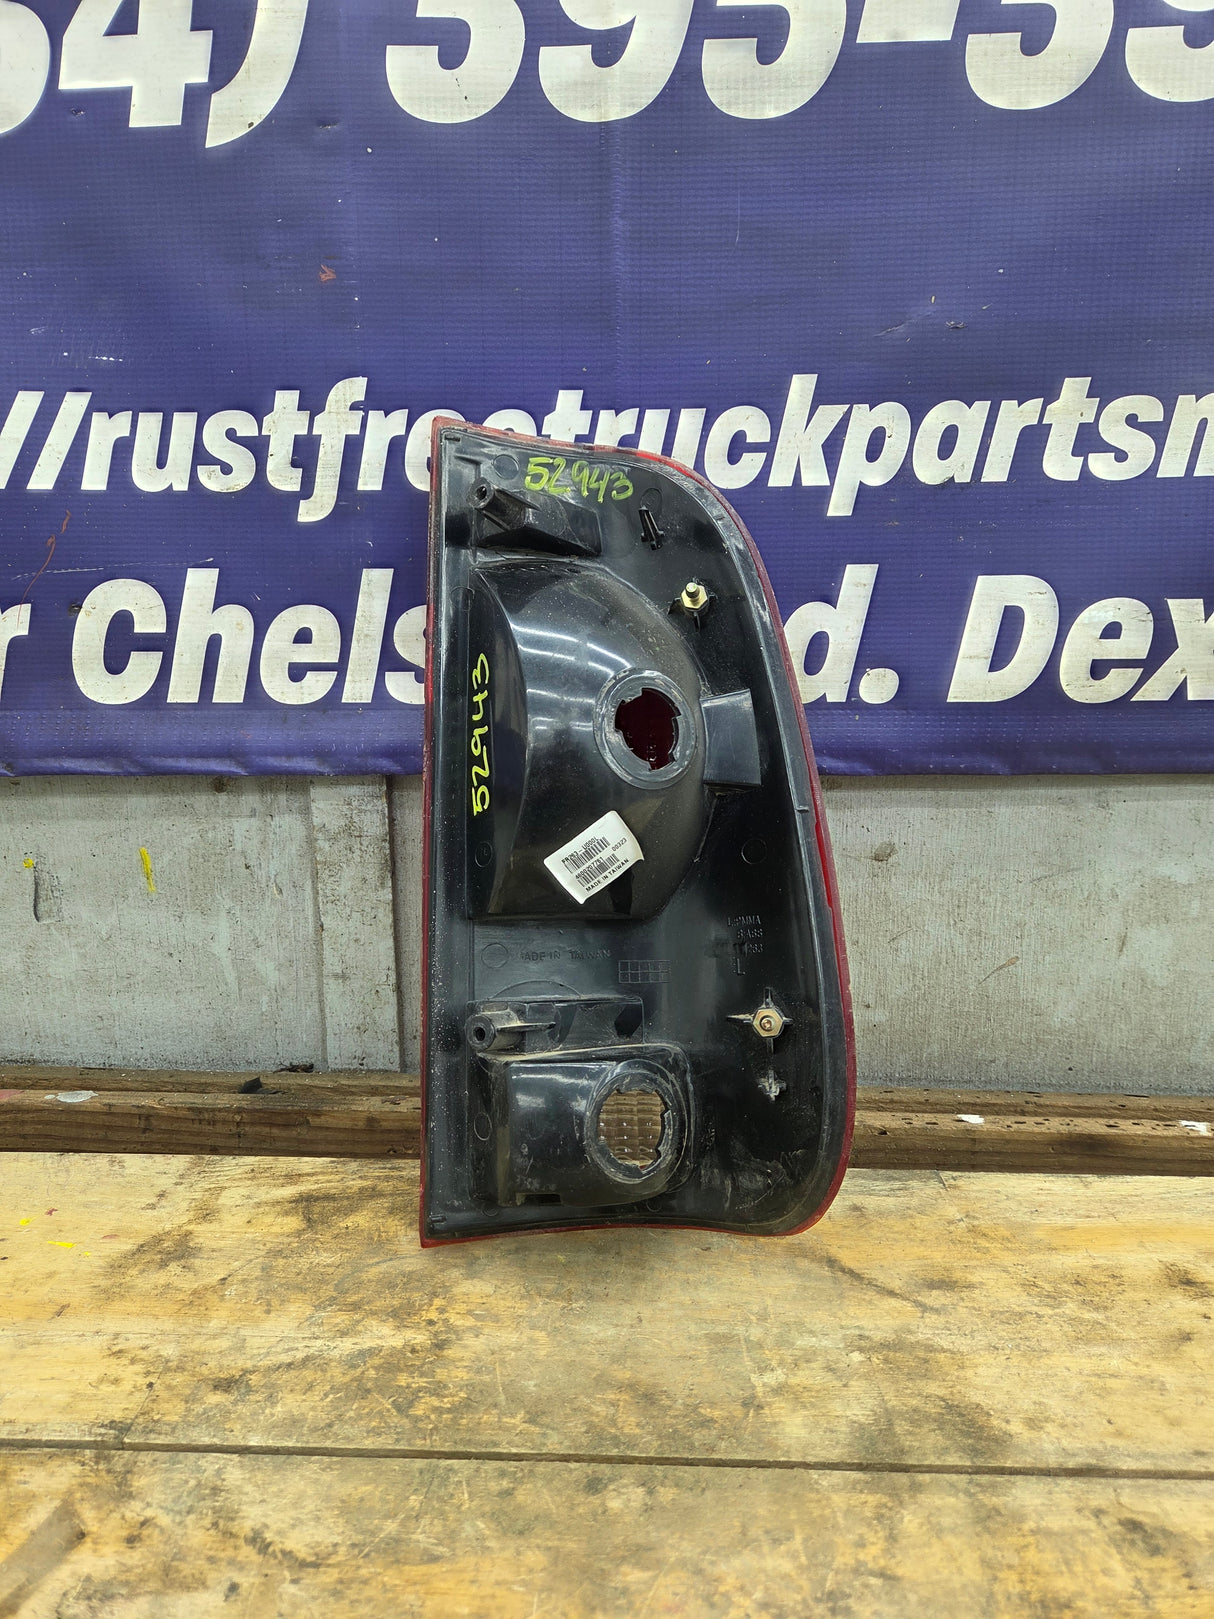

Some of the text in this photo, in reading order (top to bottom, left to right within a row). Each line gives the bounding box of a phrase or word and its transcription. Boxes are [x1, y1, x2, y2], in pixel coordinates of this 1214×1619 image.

[0, 0, 308, 148] 4)
[525, 457, 634, 503] 52943
[946, 575, 1214, 703] Dex
[471, 653, 490, 817] 52943
[585, 877, 602, 892] MADE
[608, 858, 630, 876] TAIWAN
